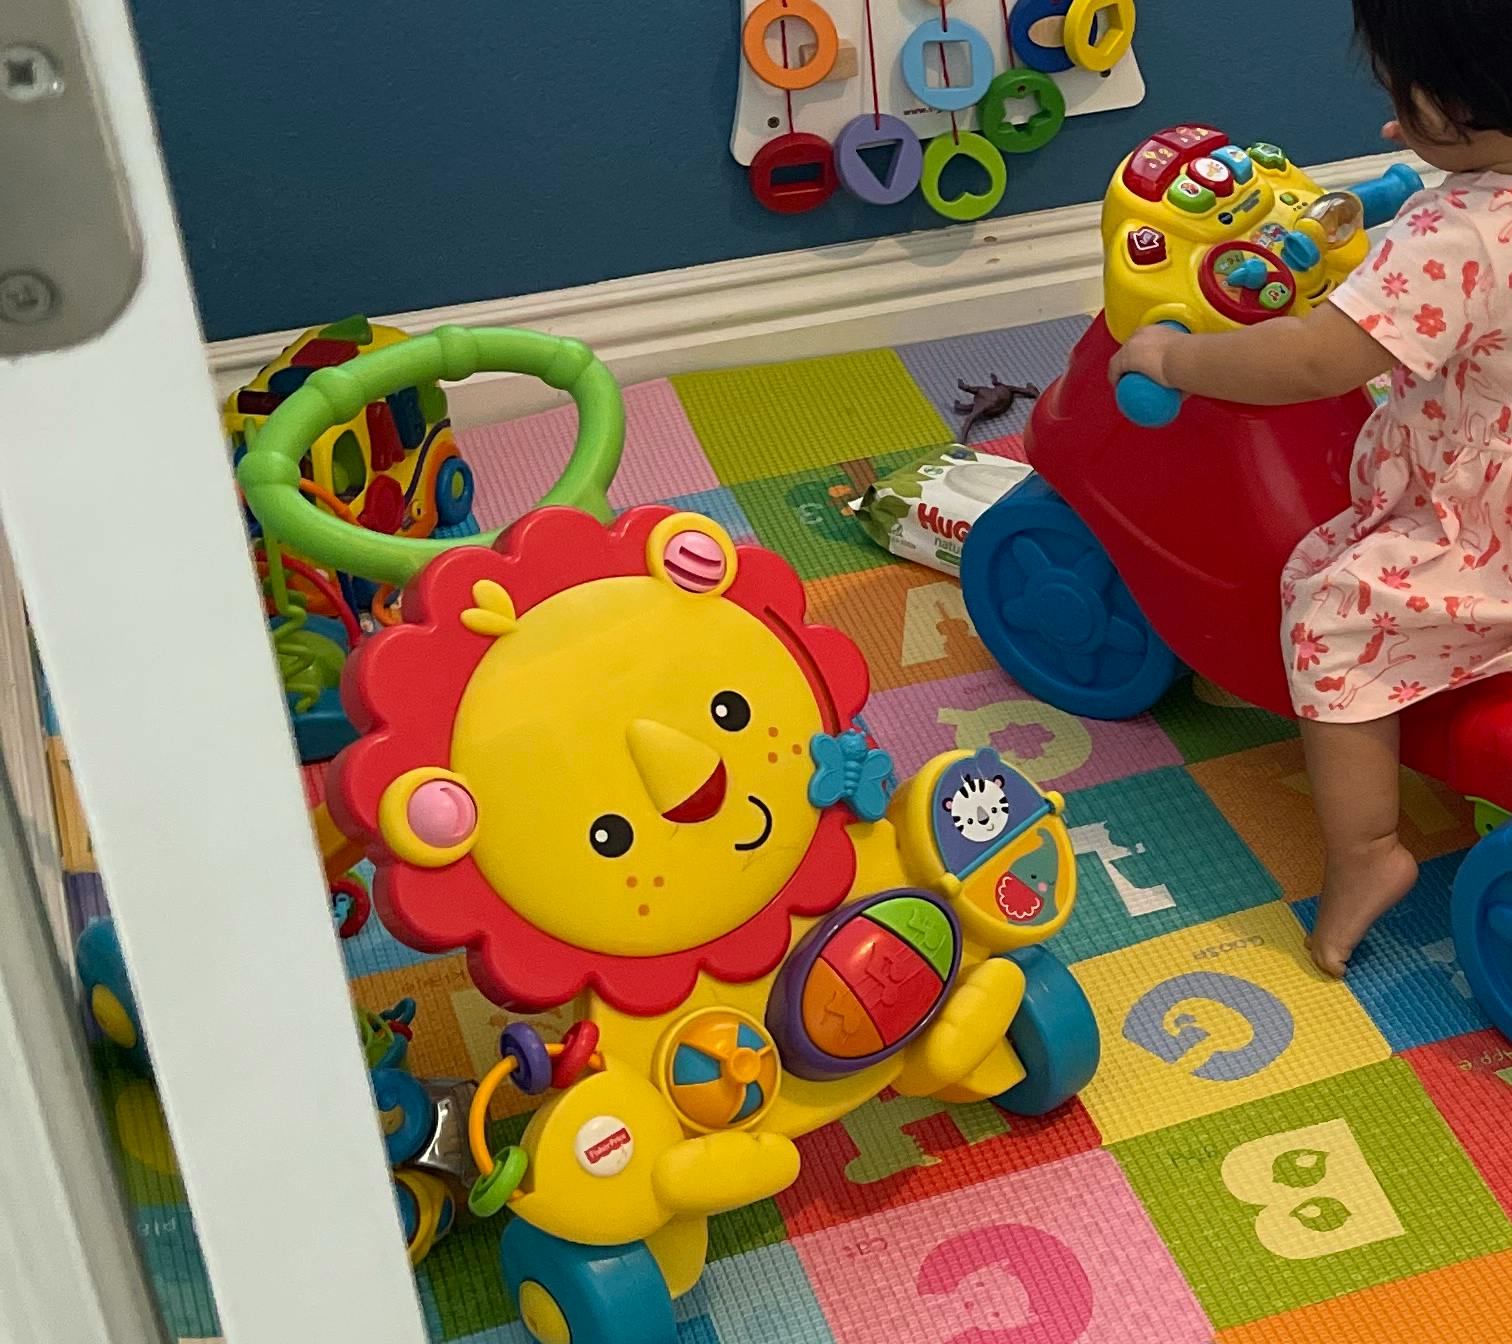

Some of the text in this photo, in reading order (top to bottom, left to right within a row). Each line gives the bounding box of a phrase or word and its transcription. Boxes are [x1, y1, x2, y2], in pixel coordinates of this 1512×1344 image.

[934, 537, 965, 555] natu
[937, 699, 1093, 783] Q
[1192, 935, 1265, 961] Goose
[1122, 971, 1294, 1081] G
[1220, 1118, 1405, 1259] B
